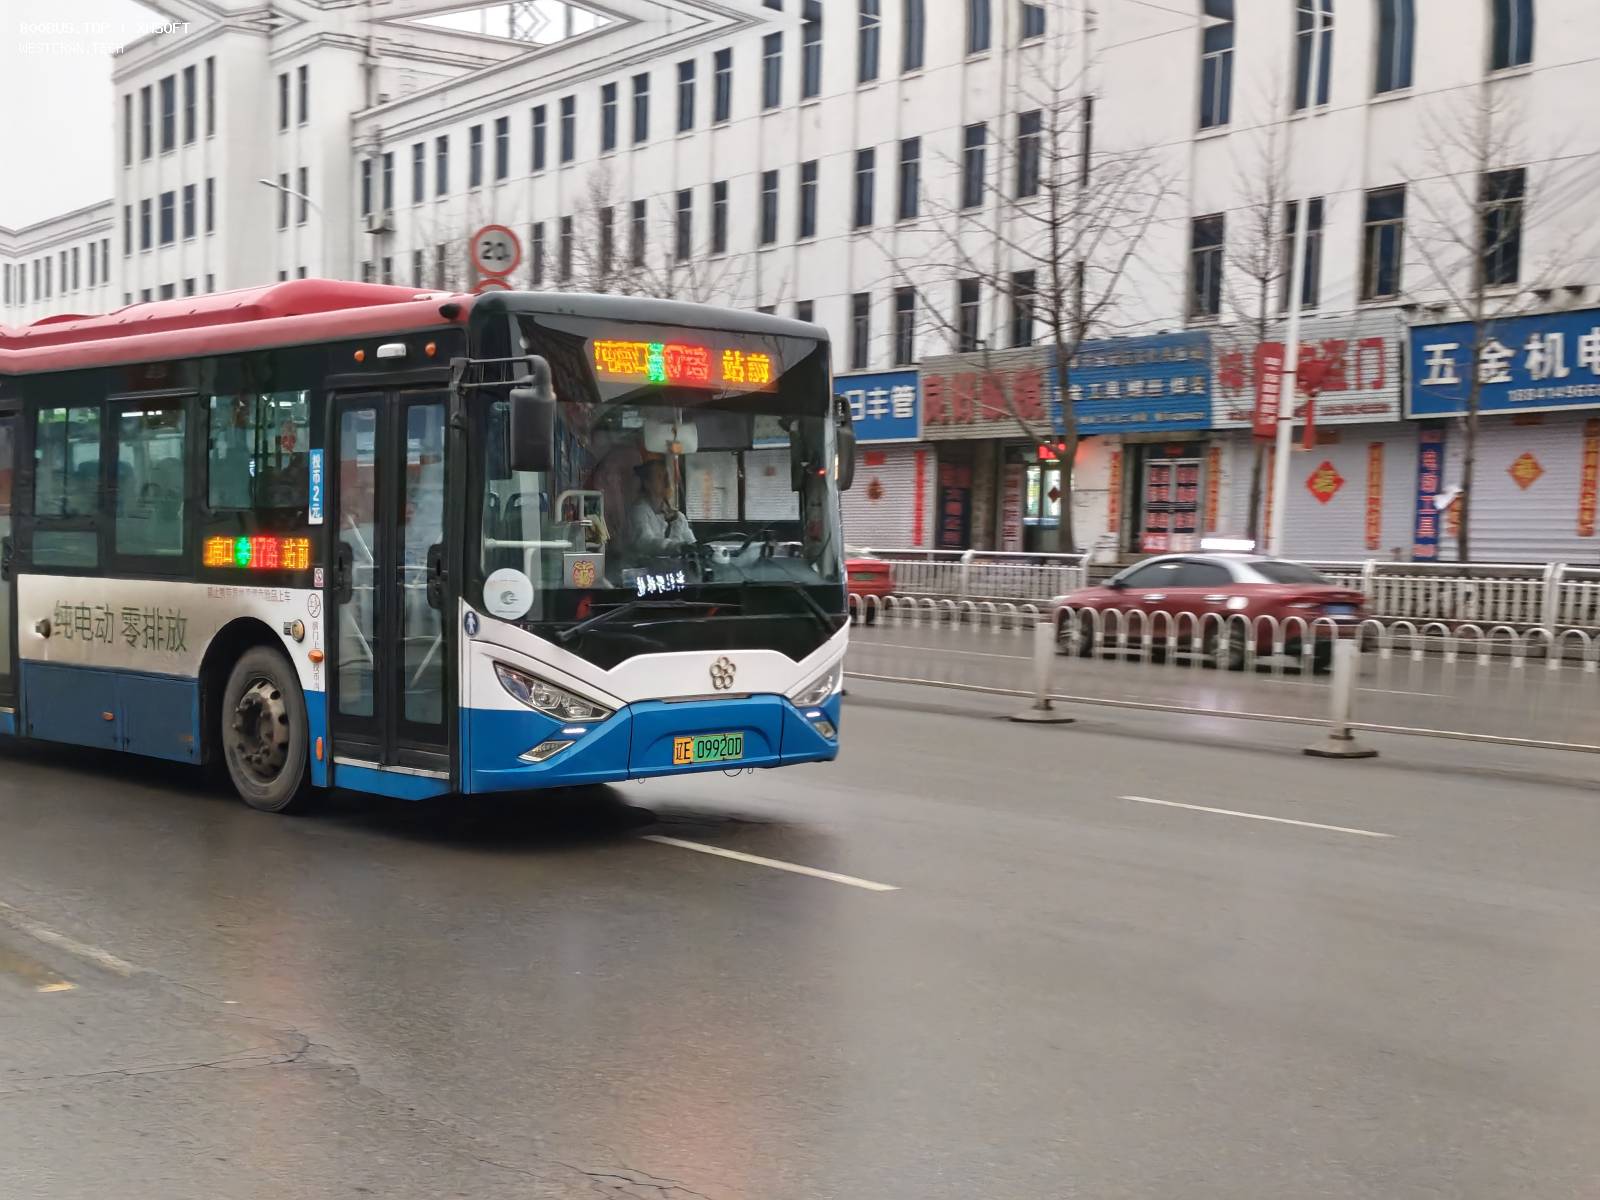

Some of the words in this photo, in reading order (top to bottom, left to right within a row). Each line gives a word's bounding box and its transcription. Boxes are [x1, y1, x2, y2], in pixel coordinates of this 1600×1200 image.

[481, 241, 508, 261] 20
[722, 349, 770, 383] 站前
[283, 537, 309, 569] 站前
[53, 600, 114, 644] 纯电动
[120, 605, 188, 652] 零排放
[697, 736, 742, 759] 09920D
